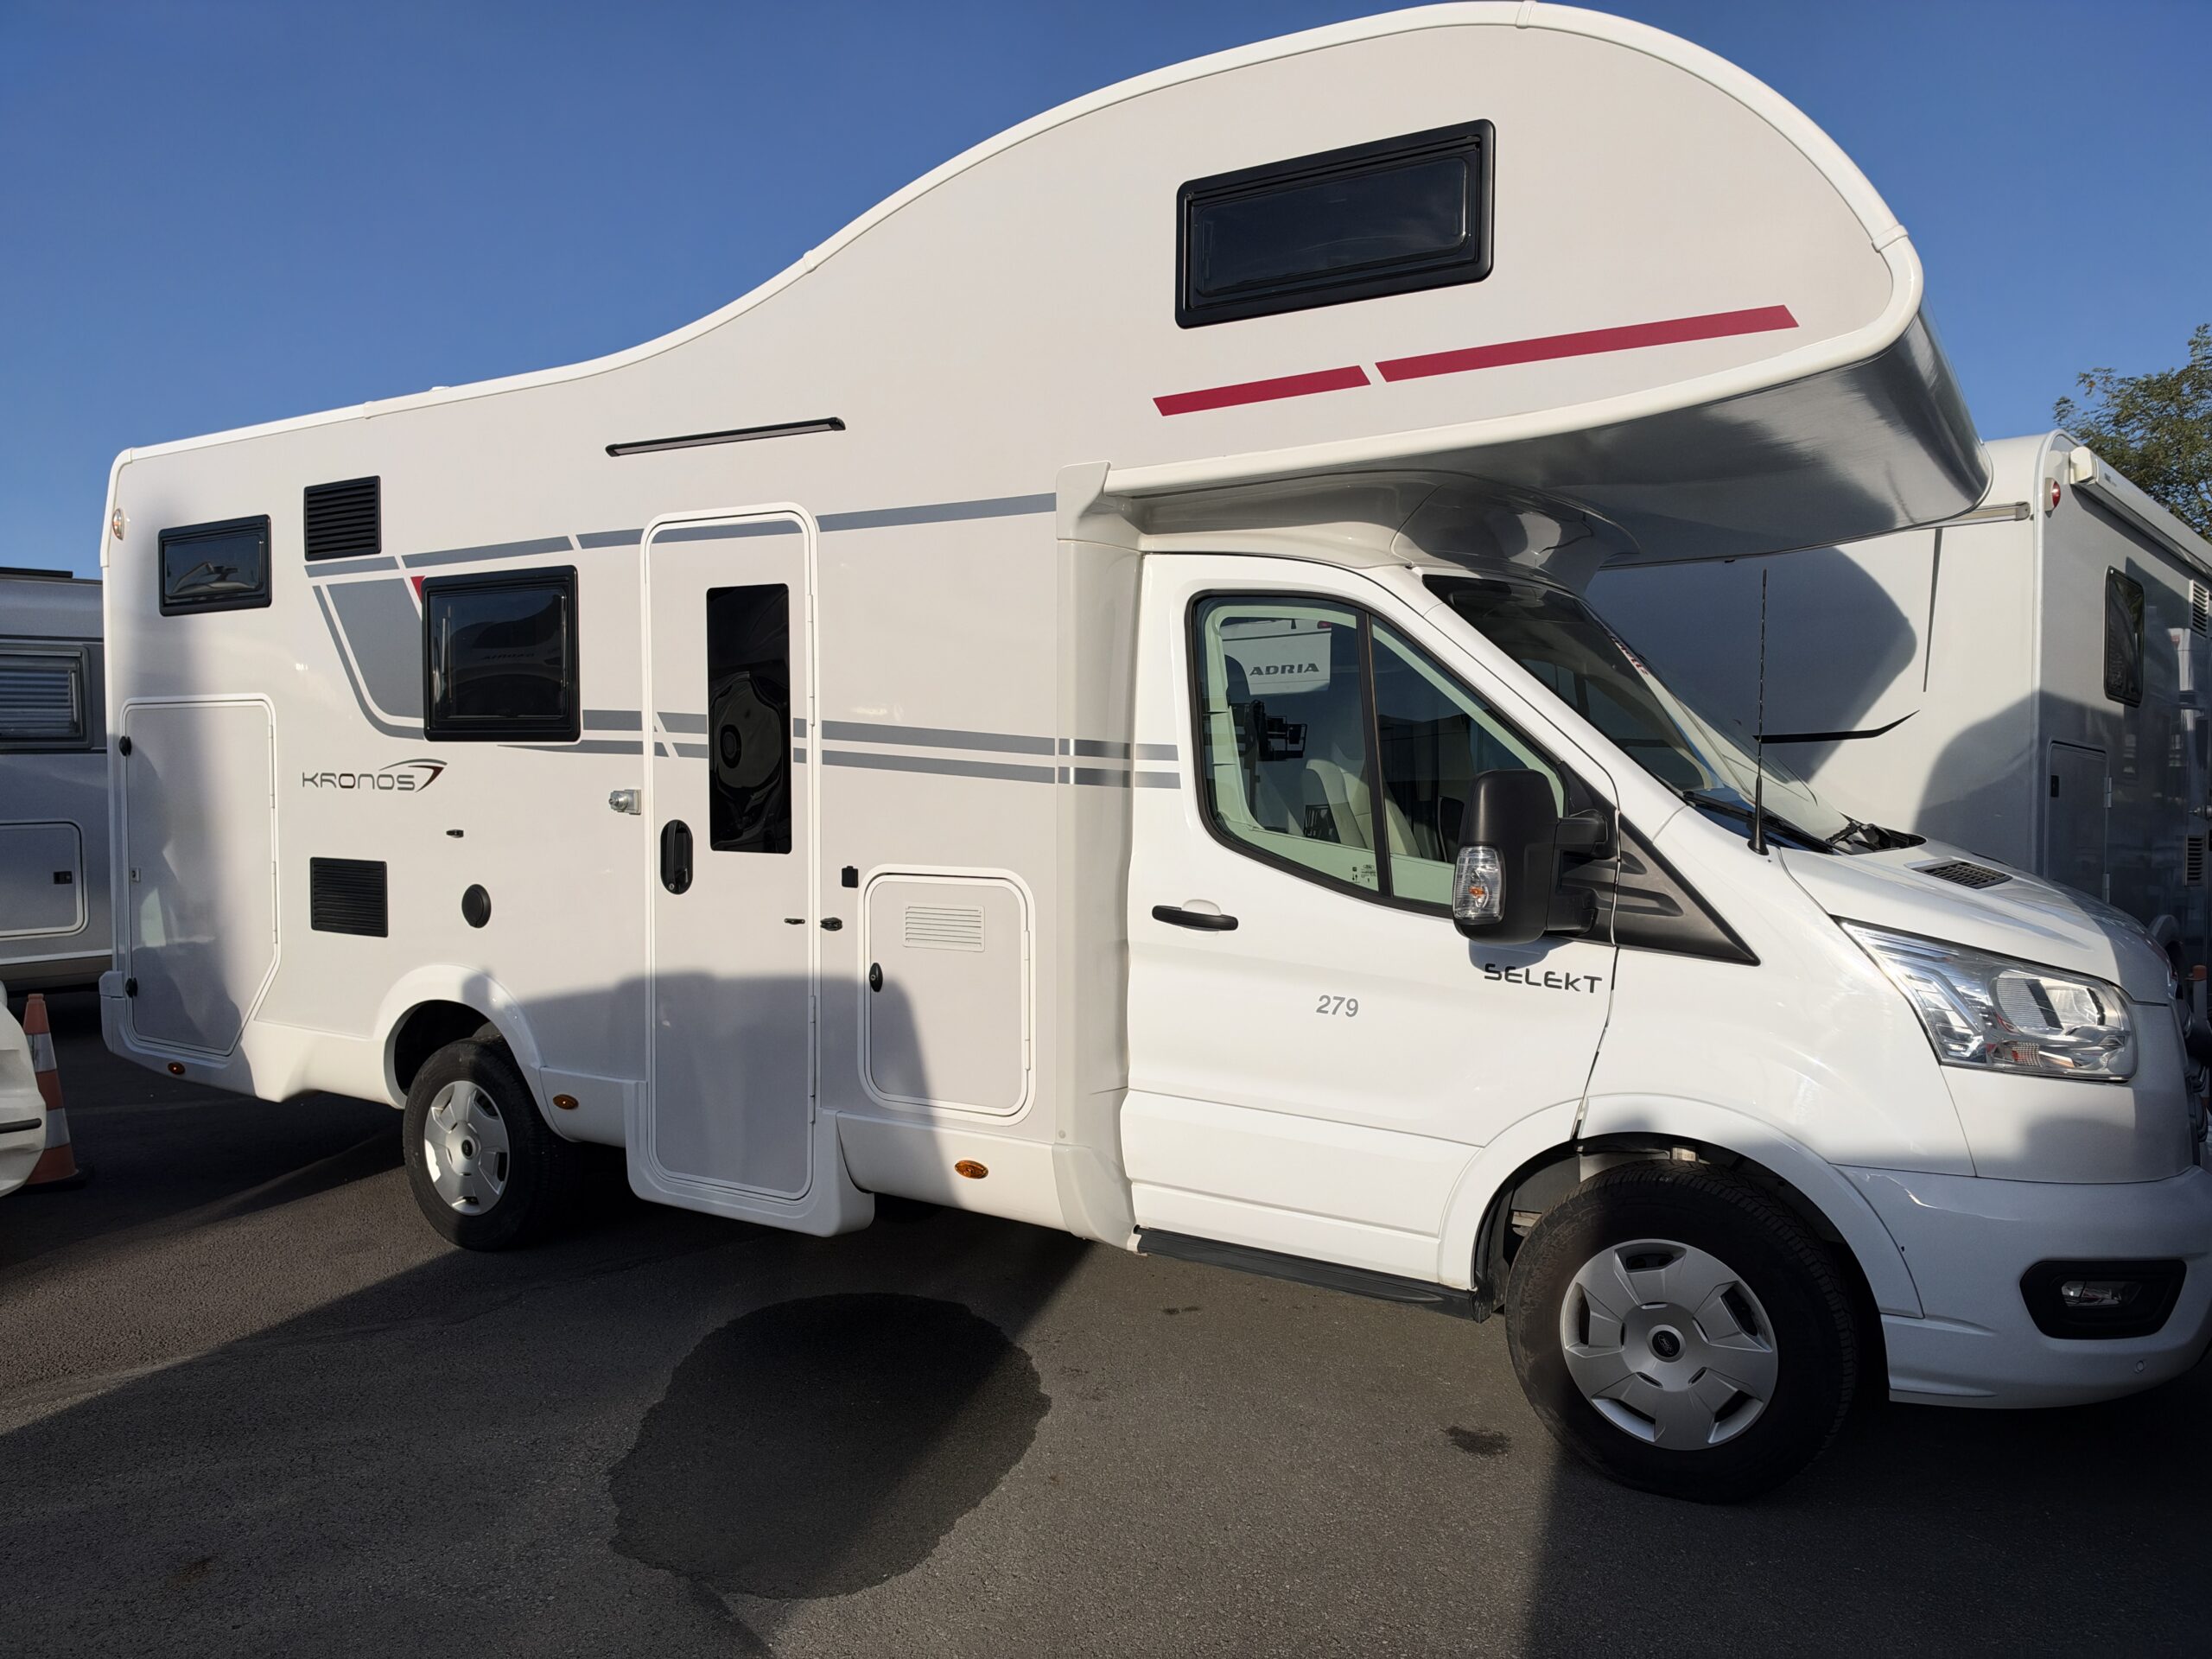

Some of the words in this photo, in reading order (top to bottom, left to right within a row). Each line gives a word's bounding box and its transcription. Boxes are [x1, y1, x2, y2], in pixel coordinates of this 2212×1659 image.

[1249, 663, 1319, 677] ADRIA
[302, 772, 416, 791] KRONOS
[1316, 995, 1359, 1018] 279
